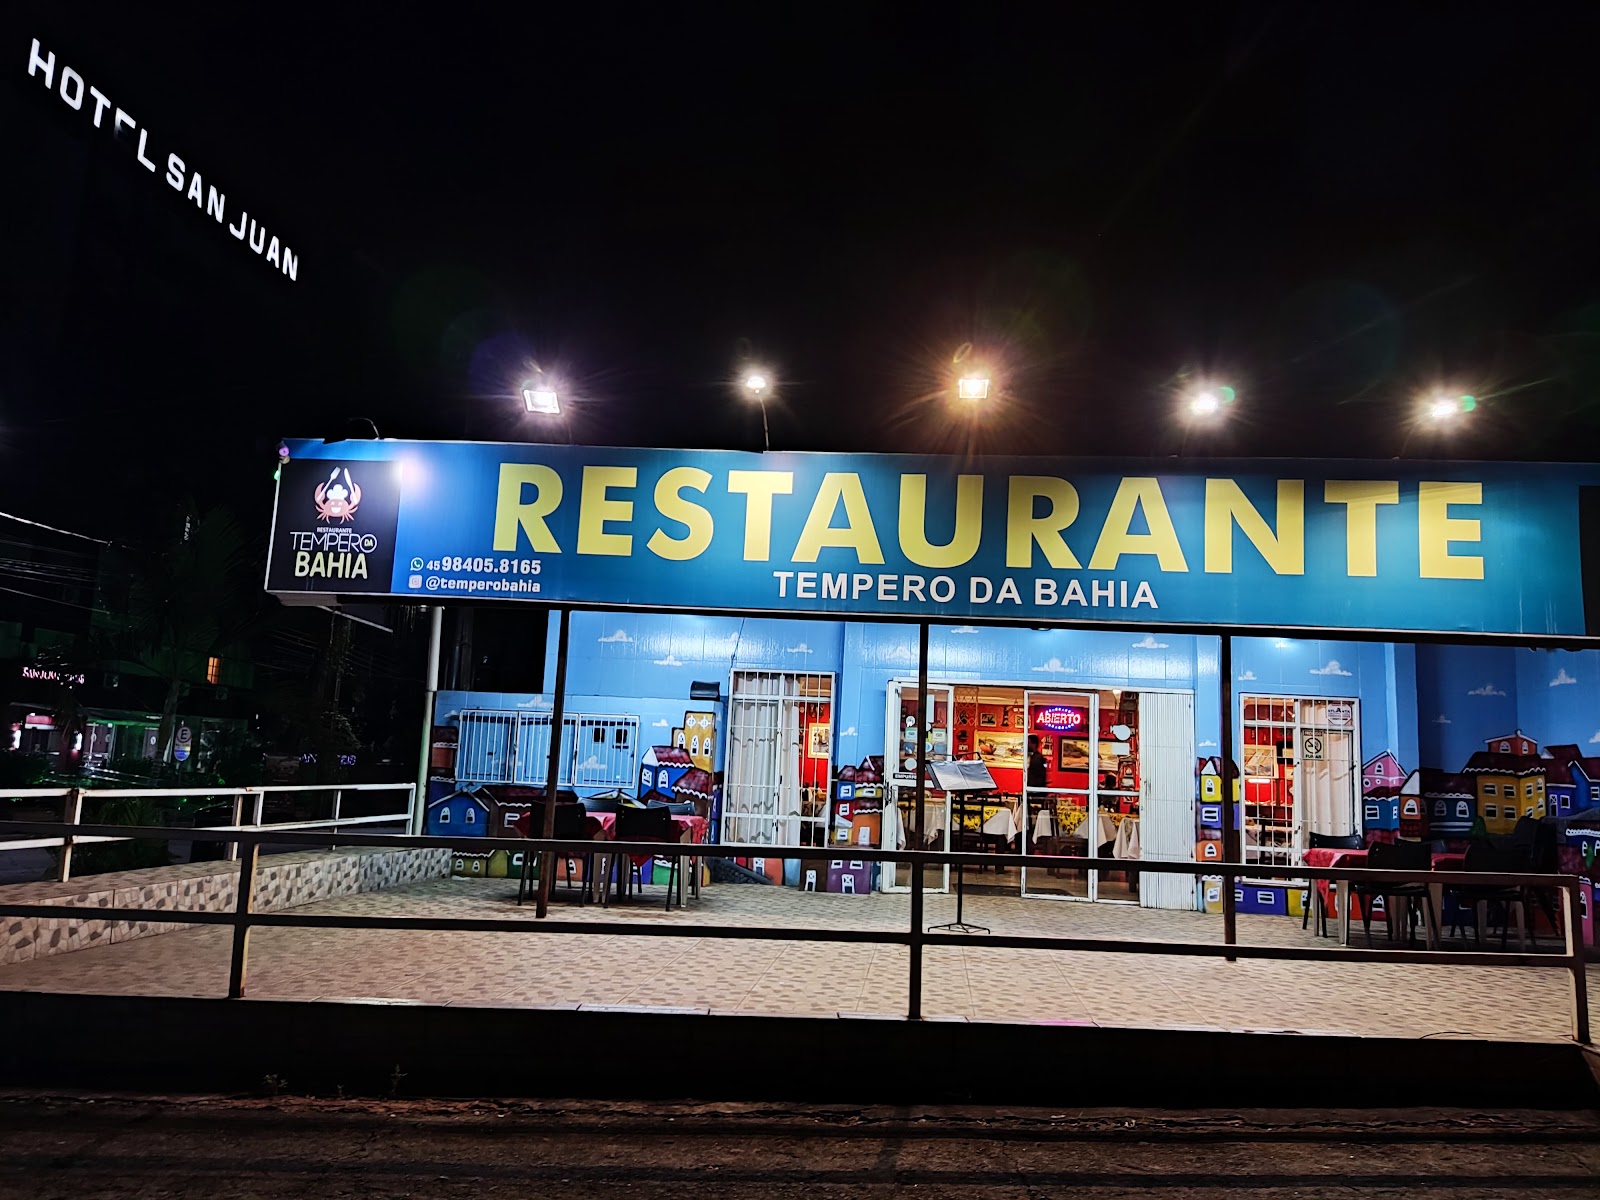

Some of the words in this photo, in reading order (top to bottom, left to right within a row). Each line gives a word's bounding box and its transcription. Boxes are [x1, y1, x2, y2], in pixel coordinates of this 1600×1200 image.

[165, 152, 226, 224] SAN
[229, 211, 298, 282] JUAN
[316, 526, 353, 534] RESTAURANTE
[493, 463, 1485, 580] RESTAURANTE
[289, 531, 378, 554] TEMPERO
[364, 538, 373, 547] DA
[294, 550, 368, 579] BAHIA
[426, 560, 440, 571] 45
[441, 556, 541, 575] 98405.8165
[425, 575, 541, 593] @temperobahia
[773, 571, 956, 603] TEMPERO
[969, 576, 1023, 605] DA
[1034, 578, 1159, 609] BAHIA
[1036, 711, 1081, 725] ABIERTO
[180, 728, 188, 740] E
